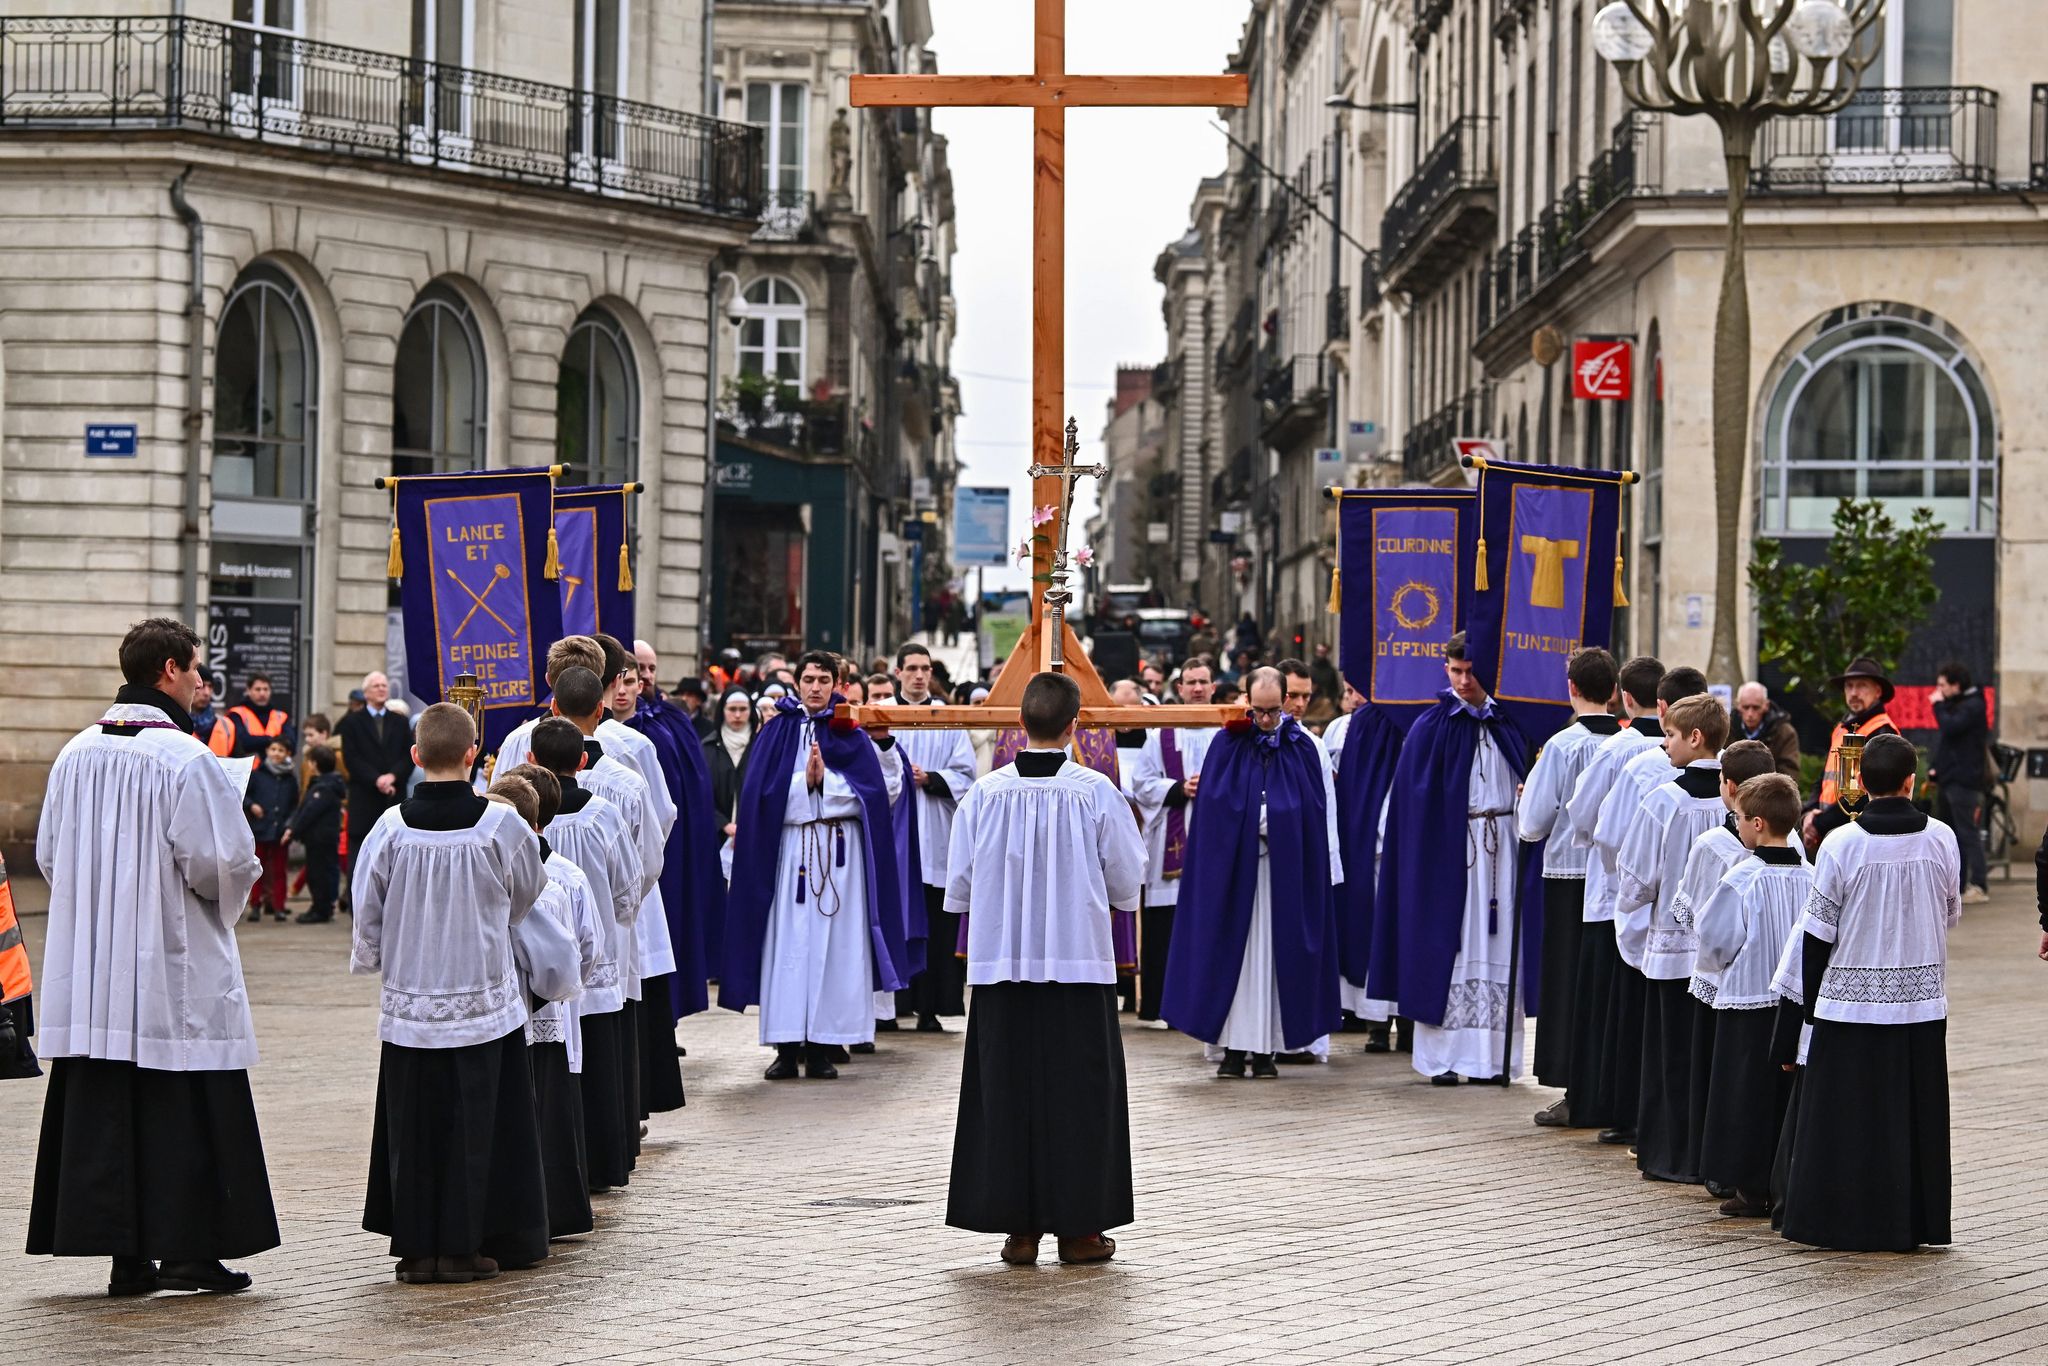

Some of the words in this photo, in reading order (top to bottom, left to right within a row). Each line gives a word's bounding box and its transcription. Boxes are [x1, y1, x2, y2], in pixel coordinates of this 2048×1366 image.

[446, 523, 505, 542] LANCE
[466, 544, 489, 561] ET
[1378, 538, 1452, 554] COURONNE
[450, 642, 519, 662] EPONGE
[475, 663, 498, 679] DE
